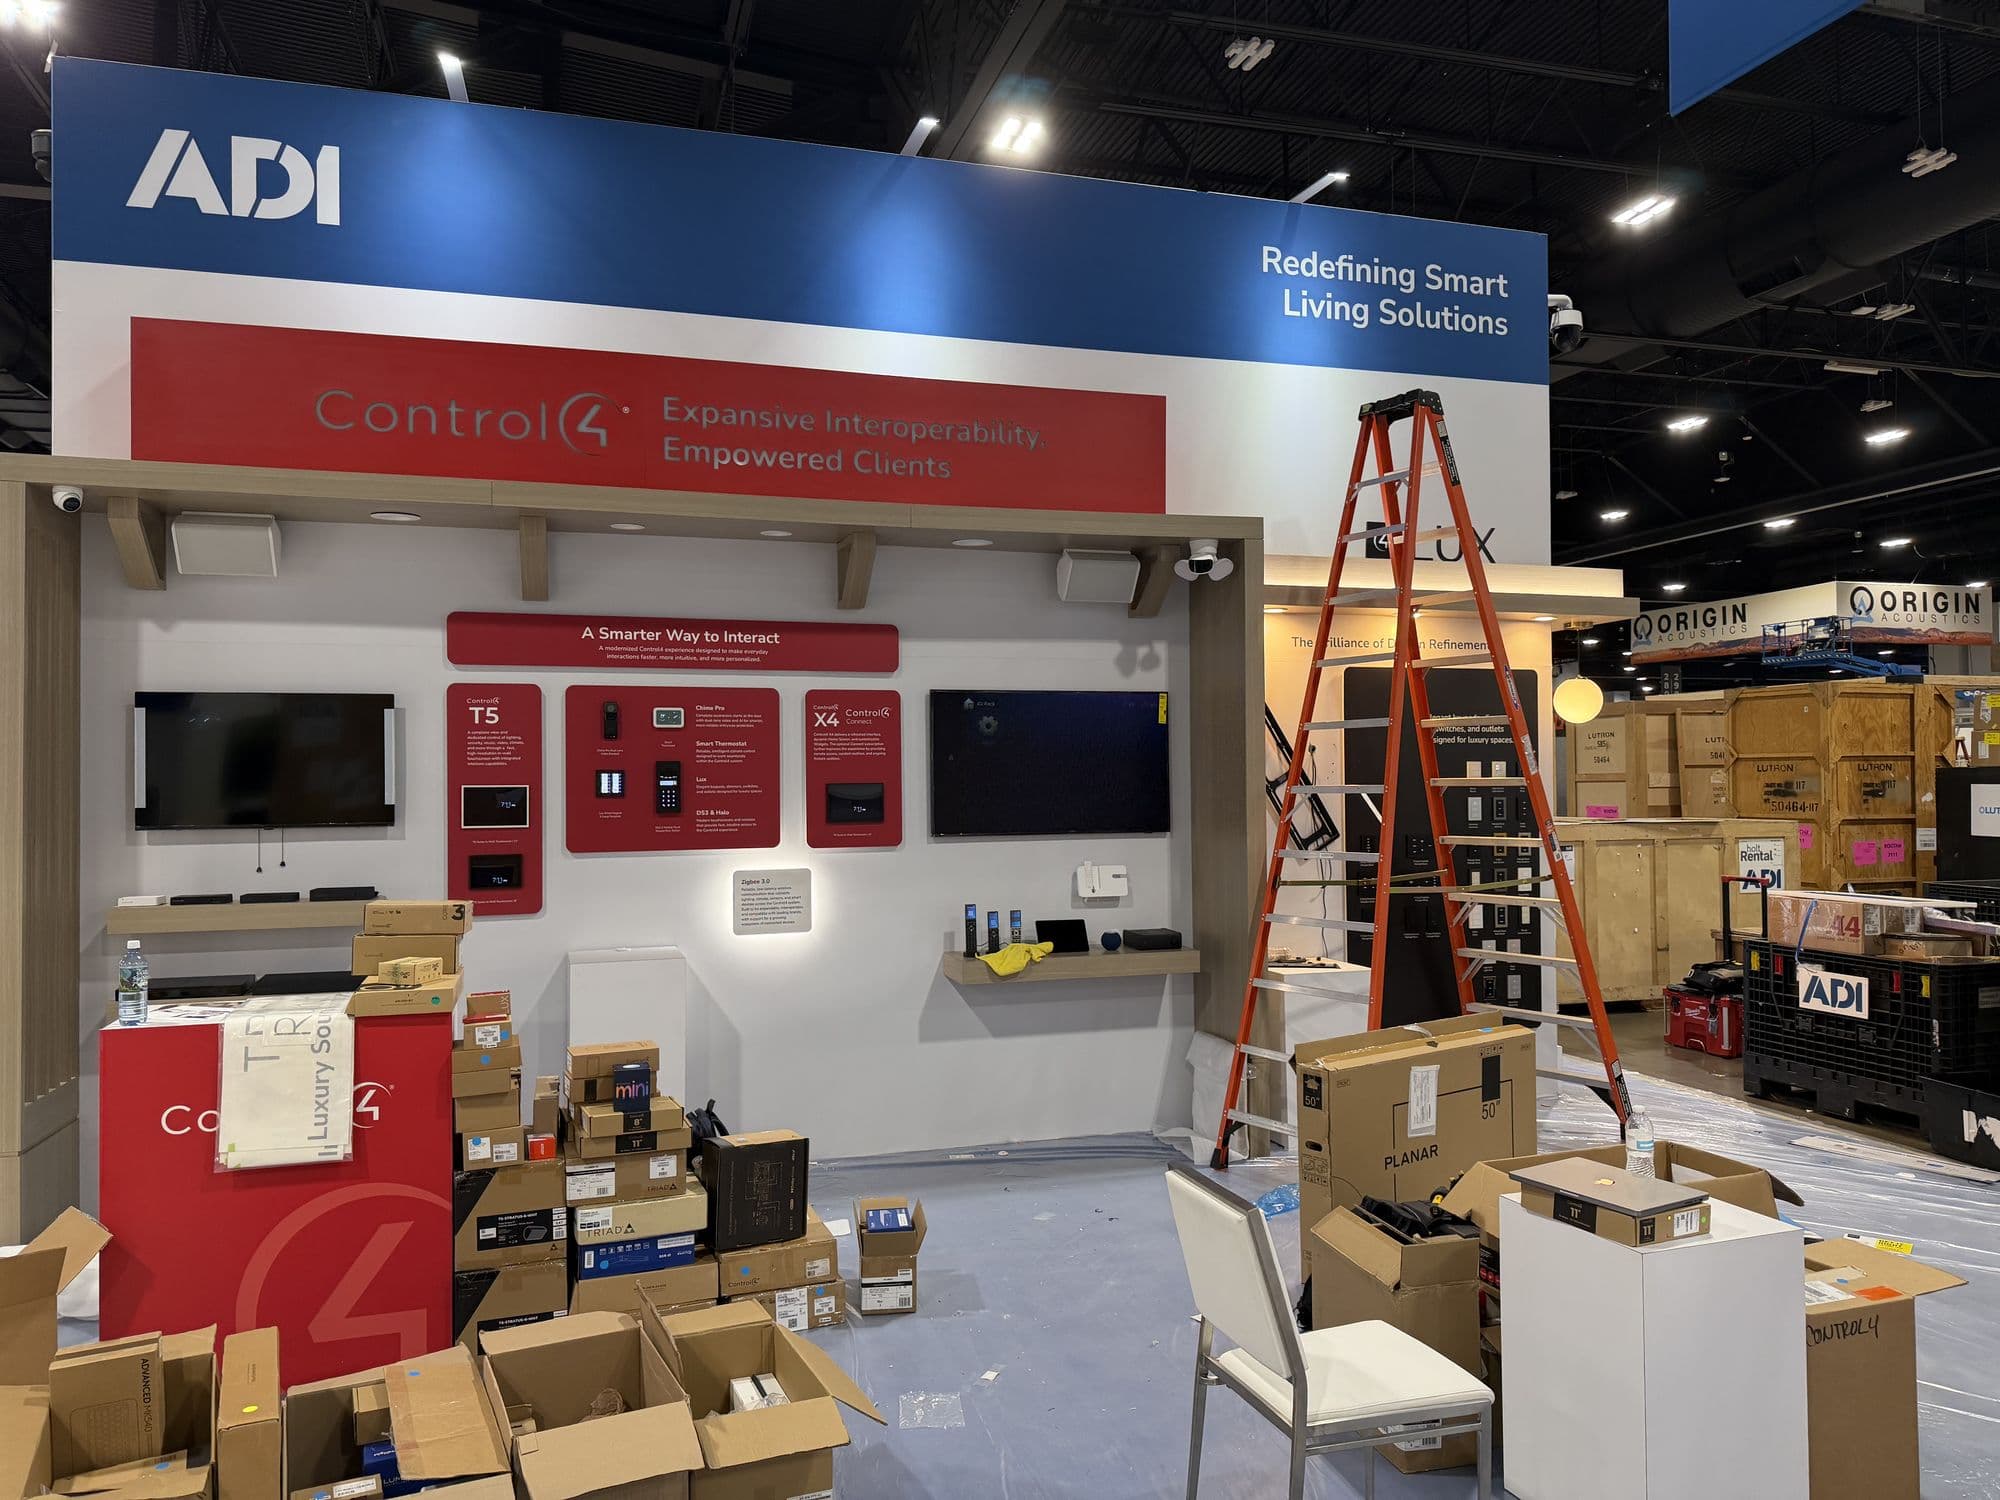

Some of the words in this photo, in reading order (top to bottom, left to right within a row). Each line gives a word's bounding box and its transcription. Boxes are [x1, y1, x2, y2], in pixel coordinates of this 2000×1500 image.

[126, 128, 340, 226] ADI
[1262, 245, 1416, 292] Redefining
[1425, 262, 1508, 299] Smart
[1283, 287, 1370, 335] Living
[1379, 299, 1509, 337] Solutions
[662, 395, 816, 433] Expansive
[825, 407, 1047, 453] Interoperability.
[662, 435, 843, 474] Empowered
[853, 447, 953, 480] Clients
[1880, 590, 1980, 615] ORIGIN
[1657, 602, 1748, 634] ORIGIN
[1881, 612, 1981, 625] ACOUSTICS
[581, 627, 594, 640] A
[599, 627, 662, 642] Smarter
[666, 629, 700, 645] Way
[705, 630, 719, 643] to
[724, 630, 780, 644] Interact
[1291, 636, 1313, 649] The
[1373, 636, 1385, 650] of
[1658, 622, 1748, 644] ACOUSTICS
[468, 706, 500, 725] T5
[814, 712, 840, 727] X4
[1467, 724, 1480, 734] and
[1481, 724, 1505, 734] outlets
[1457, 735, 1467, 744] for
[1467, 736, 1489, 747] luxury
[1756, 764, 1794, 773] LUTRON
[1857, 763, 1894, 772] LUTRON
[1740, 849, 1774, 862] Rental
[1742, 868, 1782, 890] ADI
[452, 904, 466, 921] 3
[1802, 974, 1864, 1014] ADI
[616, 1080, 649, 1099] mini
[307, 1061, 335, 1140] Luxury
[1384, 1143, 1440, 1170] PLANAR
[586, 1225, 623, 1238] TRIAD
[139, 1358, 151, 1404] ADVANCED
